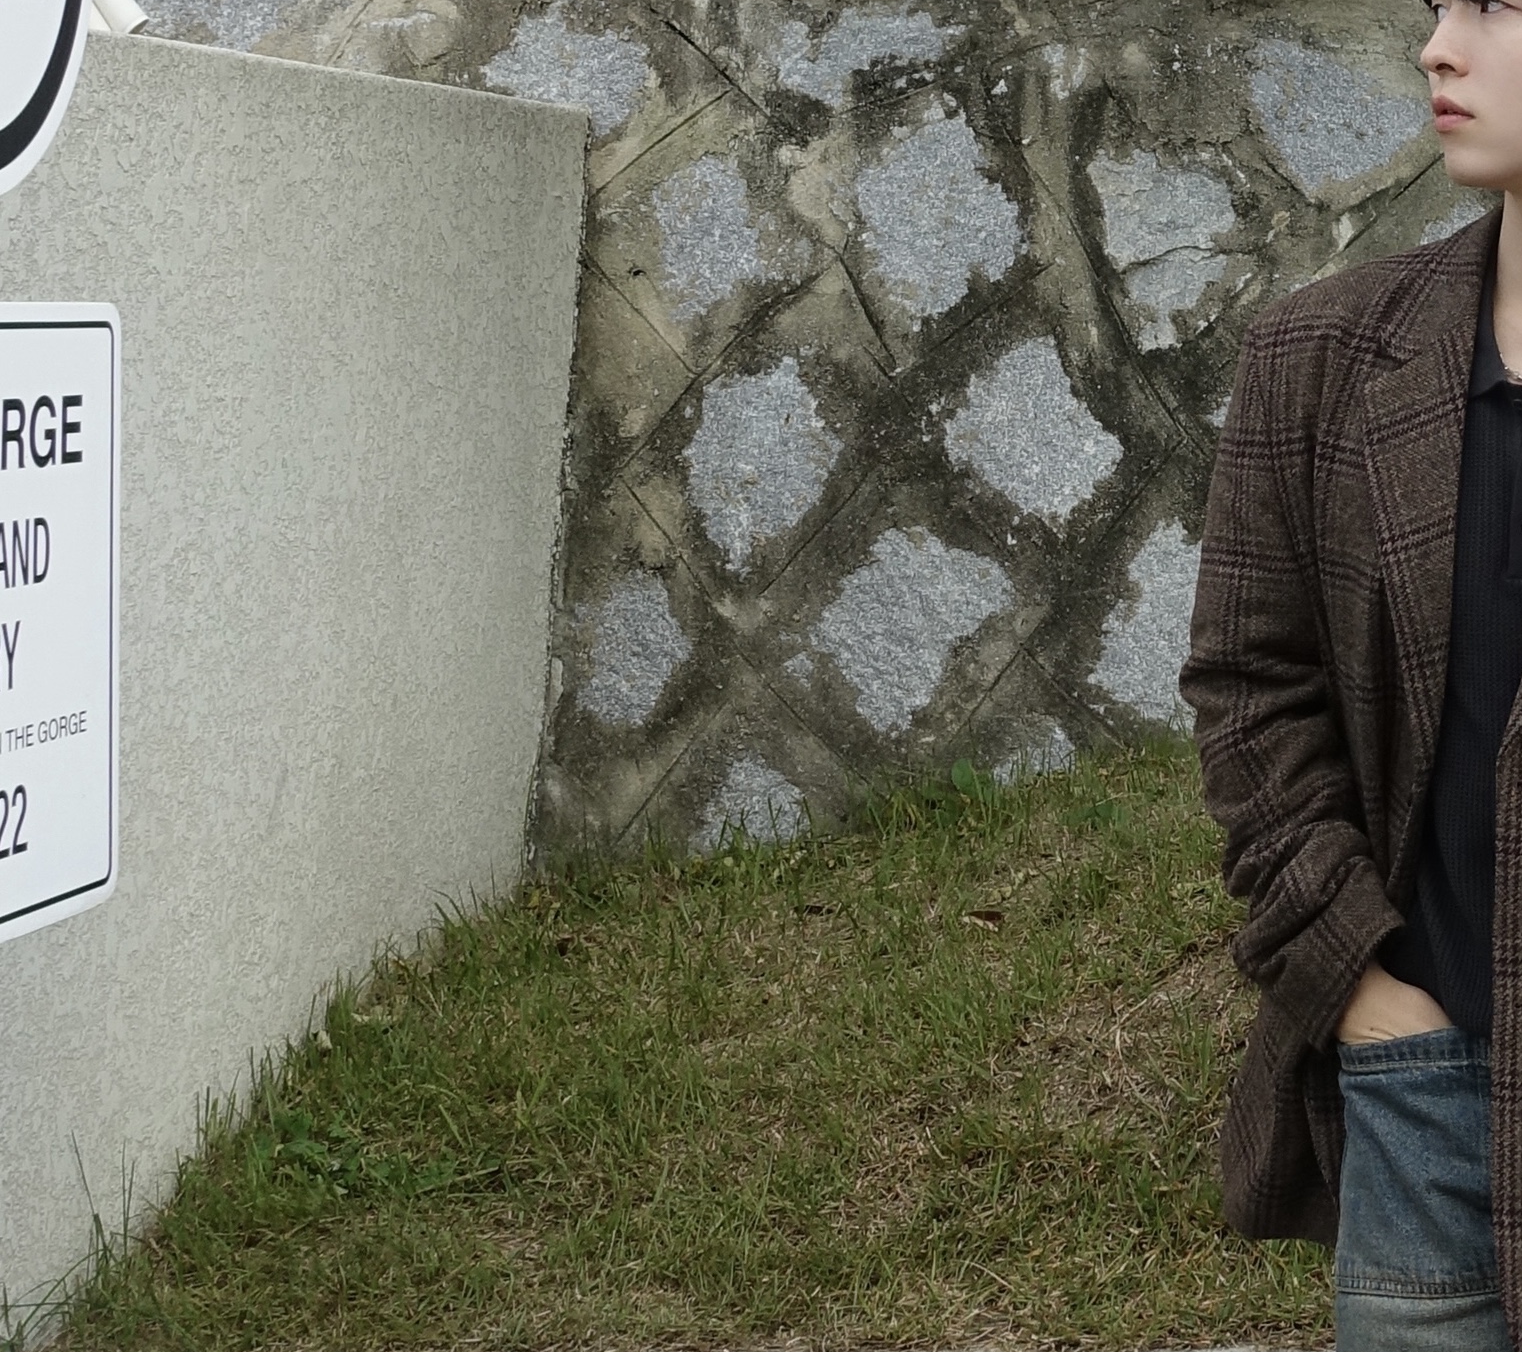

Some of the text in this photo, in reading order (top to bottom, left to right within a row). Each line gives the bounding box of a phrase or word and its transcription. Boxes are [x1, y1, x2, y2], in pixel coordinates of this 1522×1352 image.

[1, 394, 83, 471] RGE
[5, 723, 34, 753] THE
[37, 710, 88, 744] GORGE
